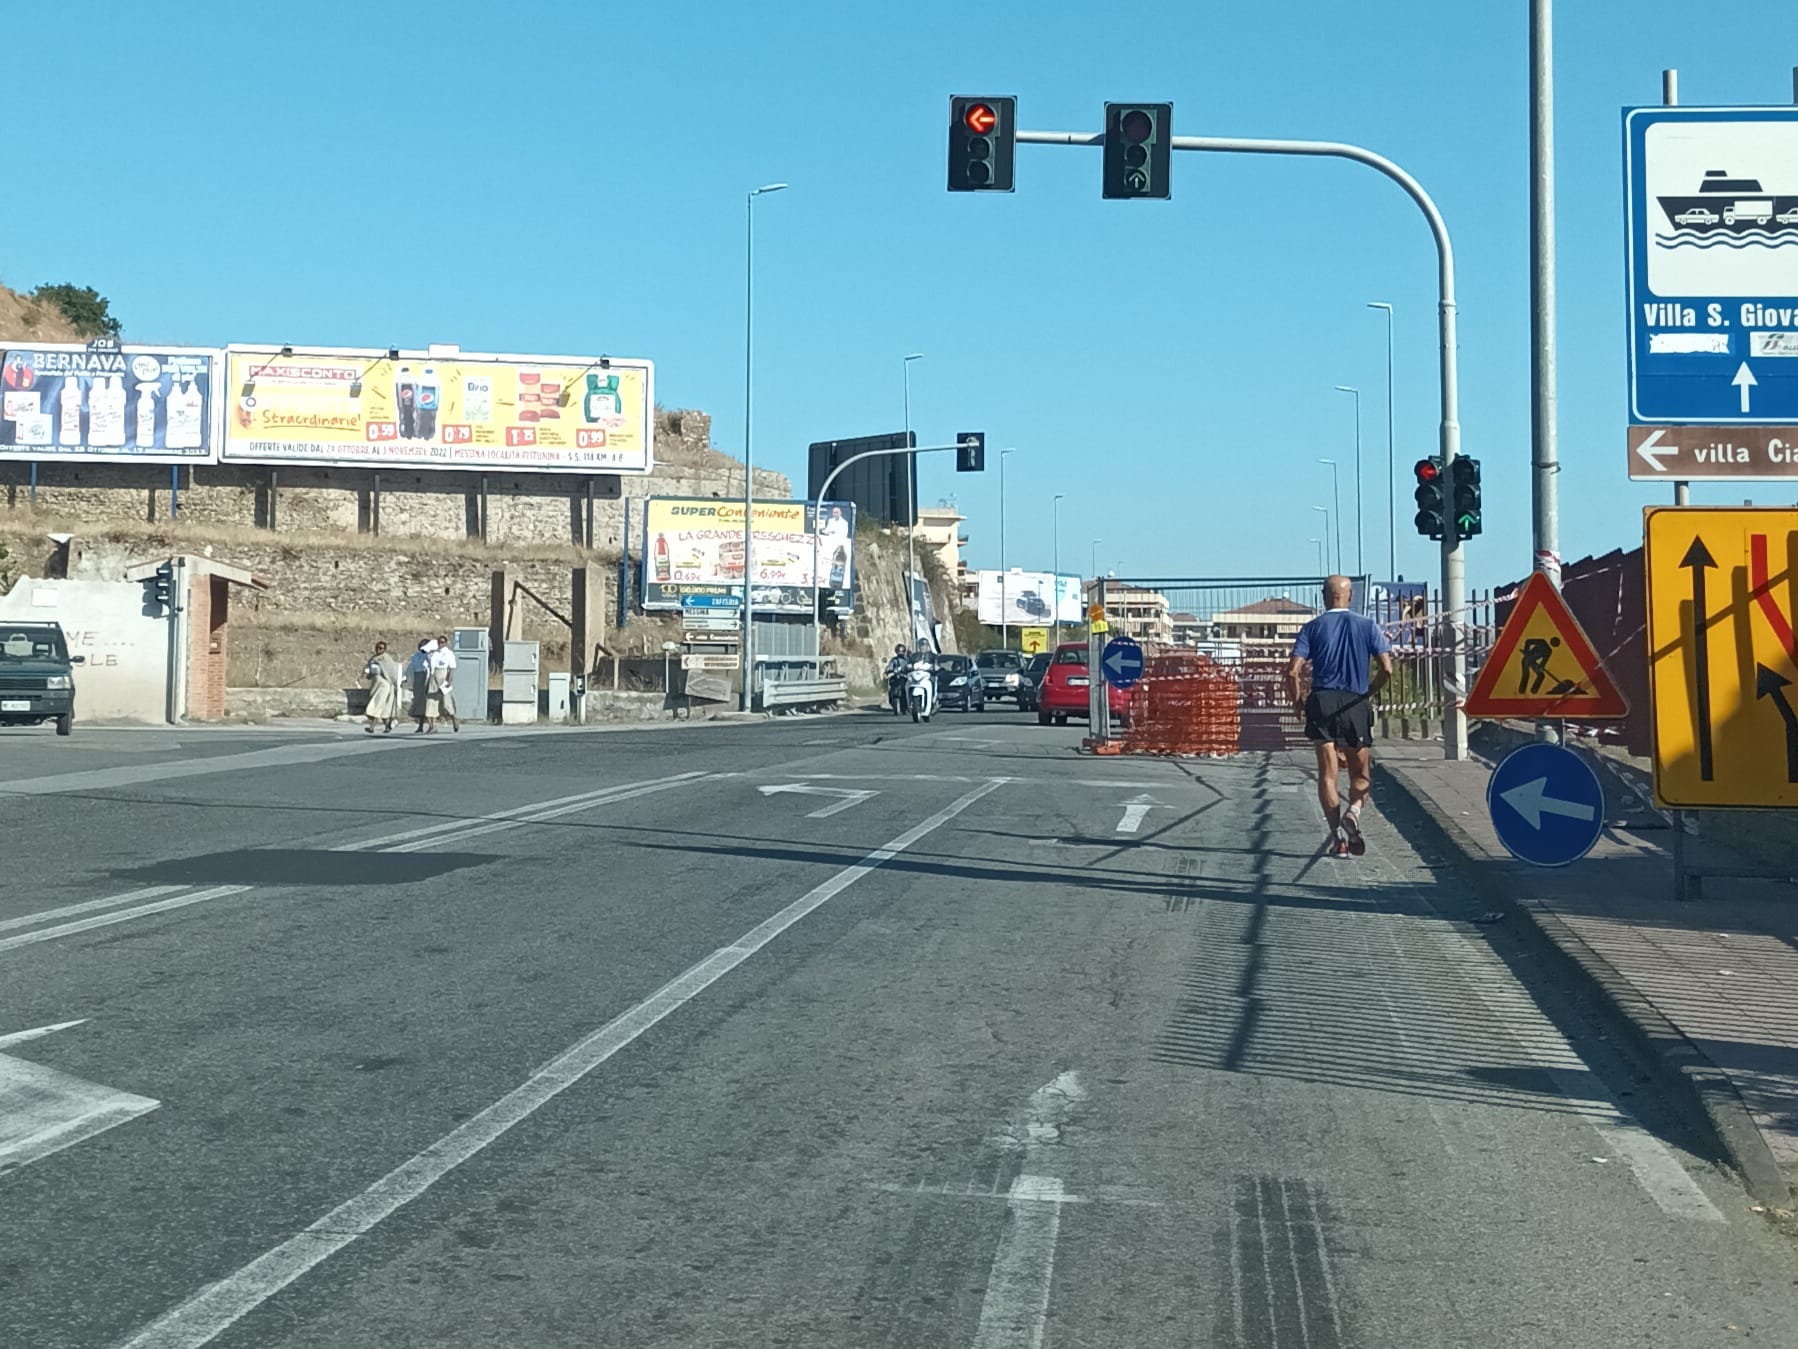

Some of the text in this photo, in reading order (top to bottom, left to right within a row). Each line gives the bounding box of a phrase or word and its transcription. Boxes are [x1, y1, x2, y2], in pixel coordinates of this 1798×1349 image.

[1644, 303, 1695, 327] Villa
[1707, 303, 1730, 327] S.
[33, 353, 127, 371] BERNAVA
[250, 366, 355, 379] MAXISCONTO
[250, 442, 280, 451] OFFERTE
[283, 443, 308, 452] VALIDE
[1694, 443, 1750, 463] villa
[679, 531, 693, 541] LA
[697, 529, 743, 540] GRANDE
